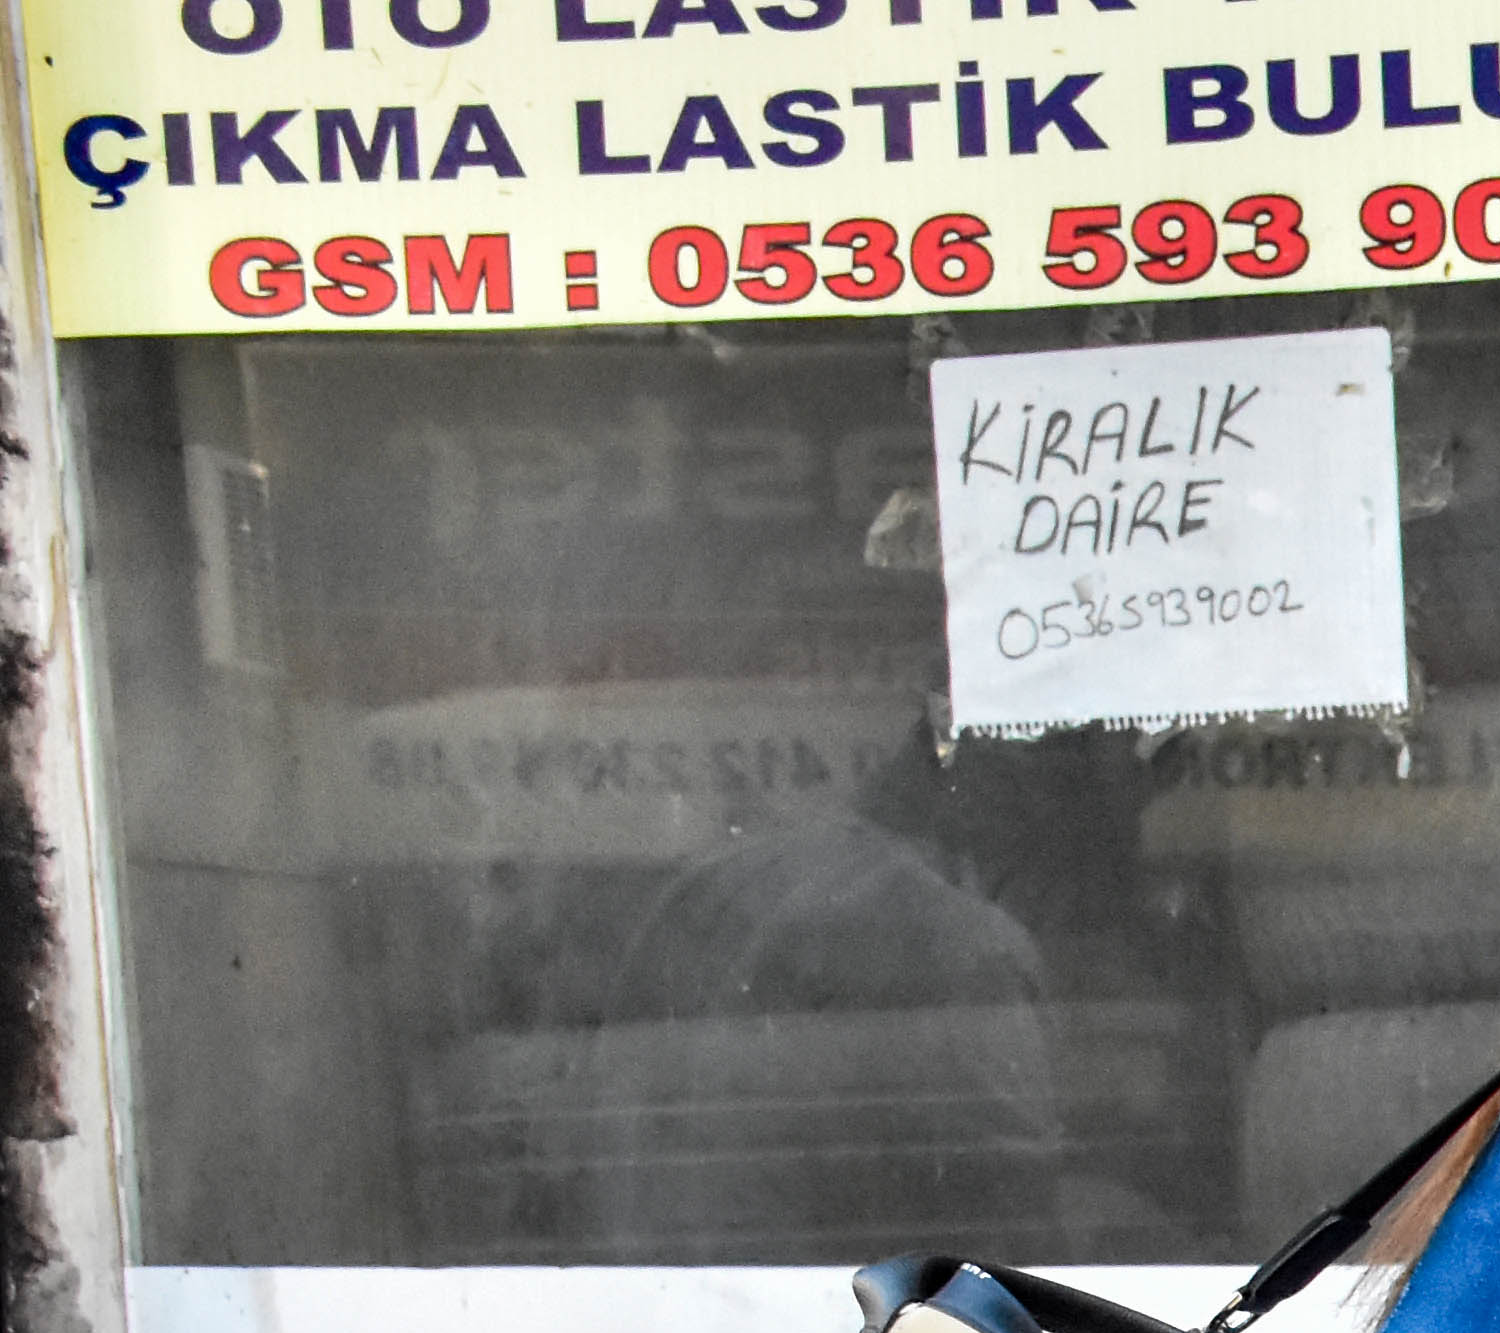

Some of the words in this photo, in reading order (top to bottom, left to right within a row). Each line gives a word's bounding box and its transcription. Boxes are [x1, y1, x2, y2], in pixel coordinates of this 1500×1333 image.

[181, 0, 491, 56] OTO
[63, 104, 526, 210] ÇIKMA
[576, 60, 1109, 176] LASTİK
[209, 232, 515, 318] GSM
[647, 212, 995, 309] 0536
[1041, 193, 1311, 290] 593
[1014, 478, 1223, 555] DAİRE
[998, 579, 1304, 660] 05365939002
